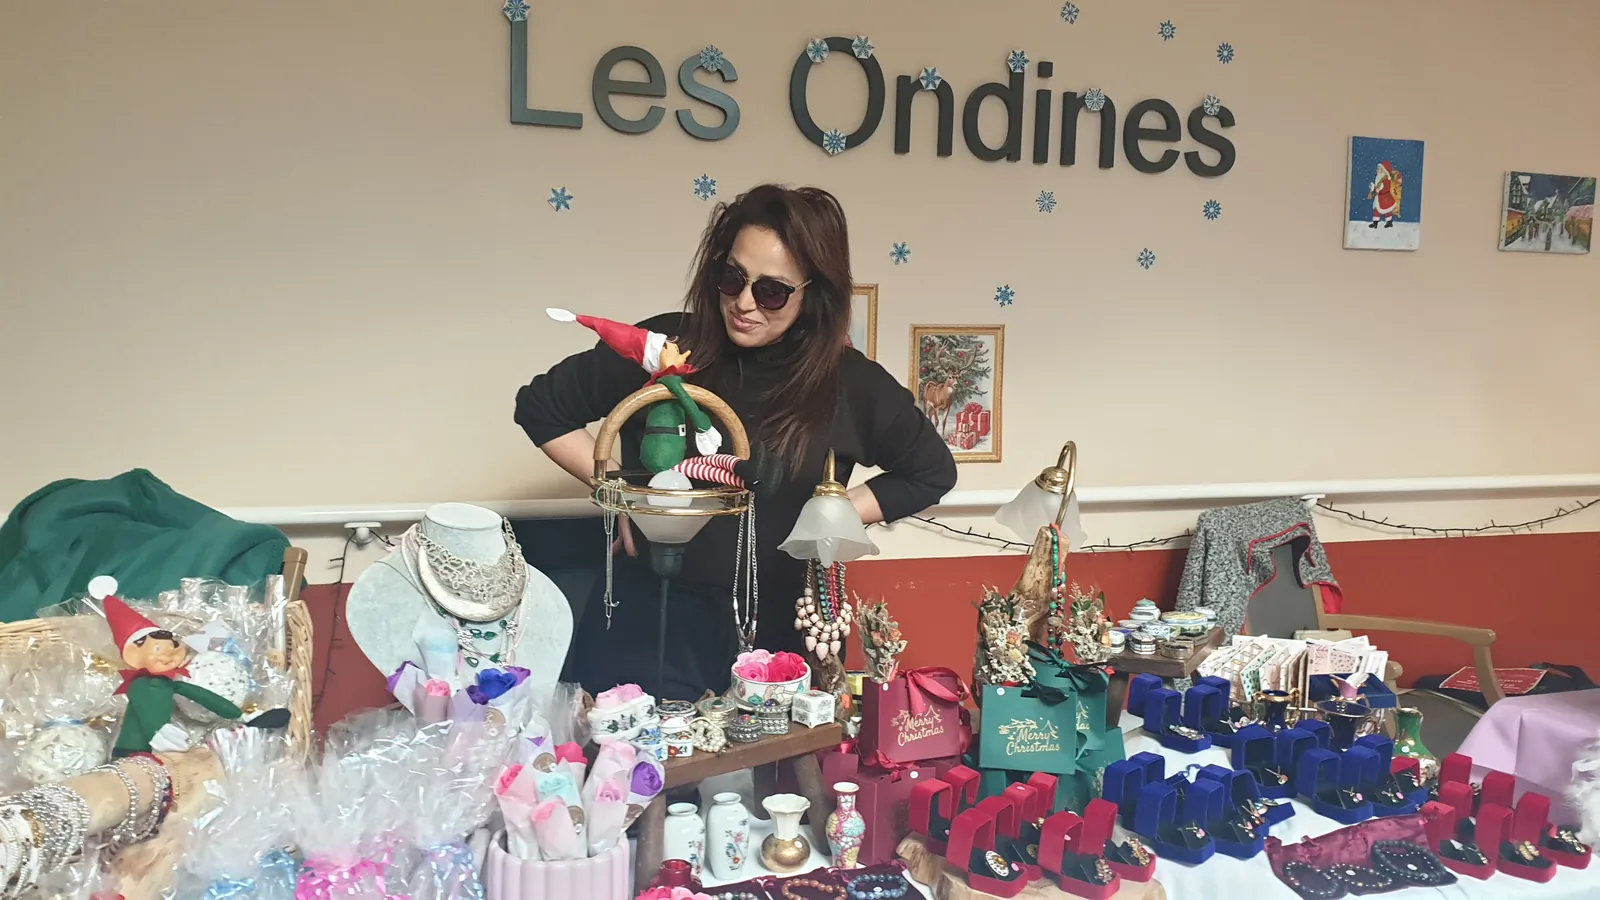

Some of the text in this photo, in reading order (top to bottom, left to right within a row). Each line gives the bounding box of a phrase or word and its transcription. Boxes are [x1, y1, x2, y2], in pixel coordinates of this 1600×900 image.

[509, 8, 1237, 178] Les Ondines
[904, 716, 935, 732] Merry
[897, 725, 944, 747] Christmas
[1016, 727, 1050, 745] Merry
[1006, 741, 1060, 756] Christmas
